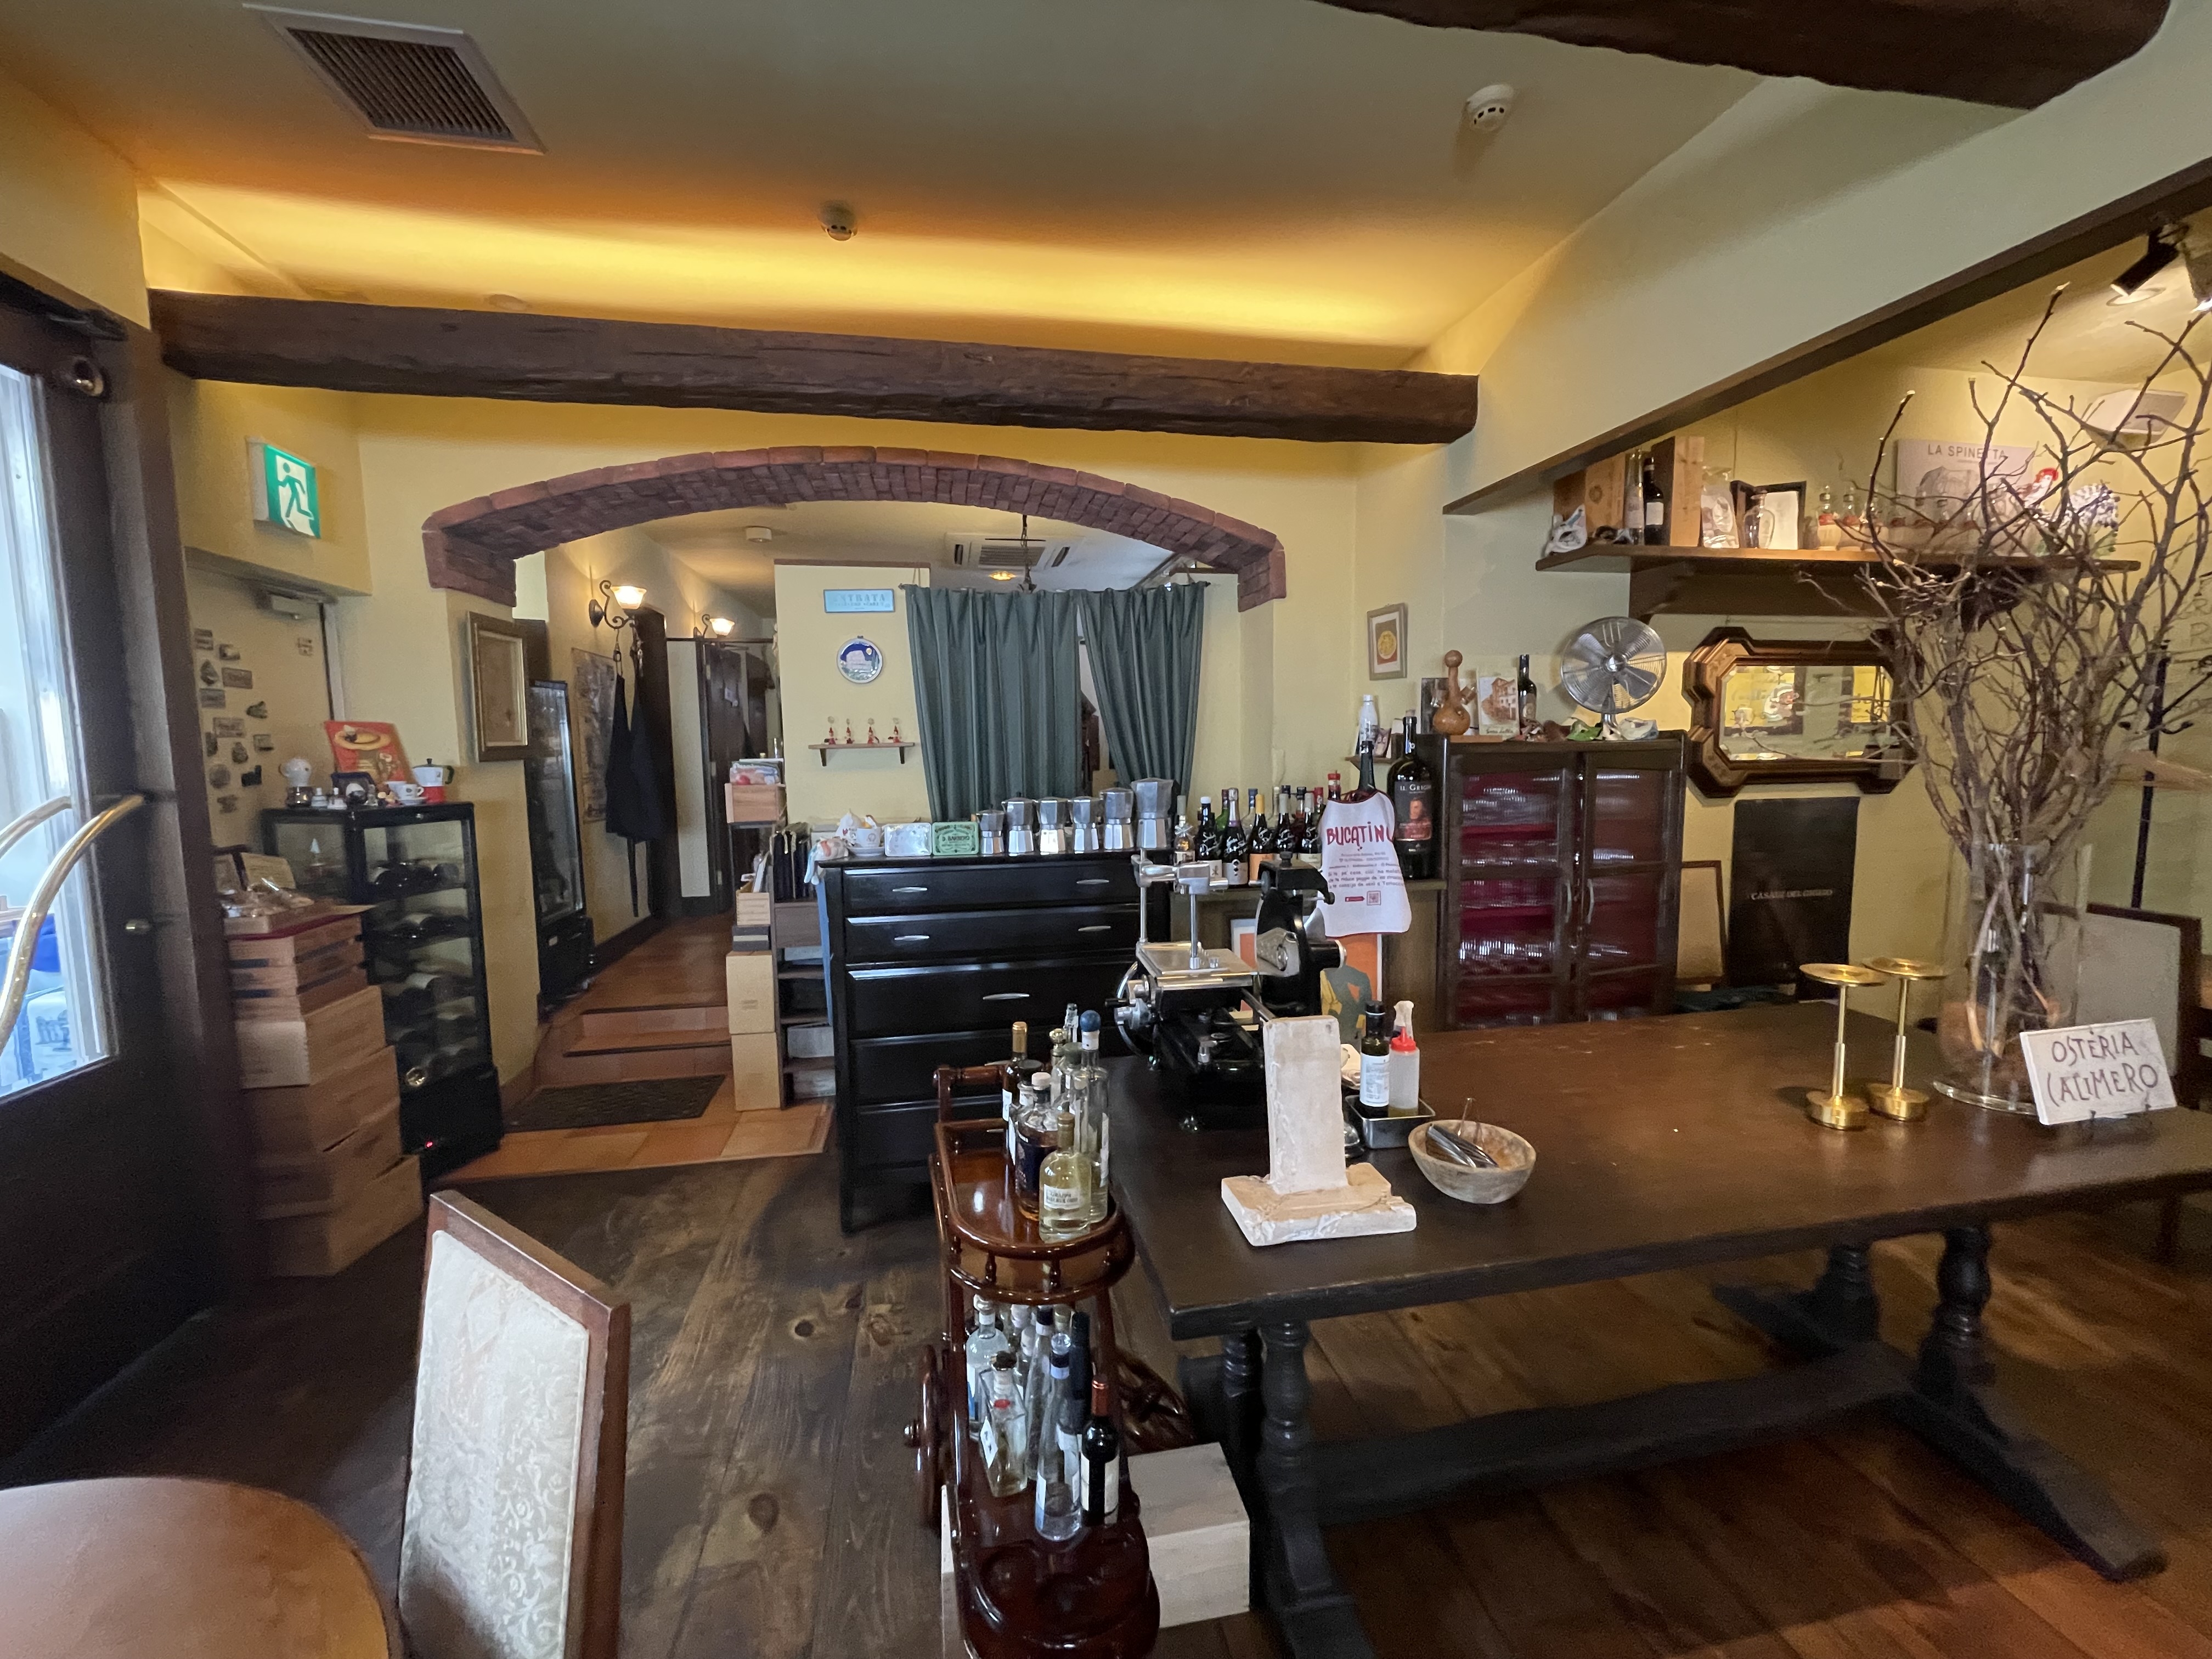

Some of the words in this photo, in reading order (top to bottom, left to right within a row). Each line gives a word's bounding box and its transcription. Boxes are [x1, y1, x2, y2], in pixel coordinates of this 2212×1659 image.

[1928, 443, 1942, 455] LA
[2051, 1031, 2140, 1066] OSTERIA
[2047, 1063, 2159, 1107] CALIMERO
